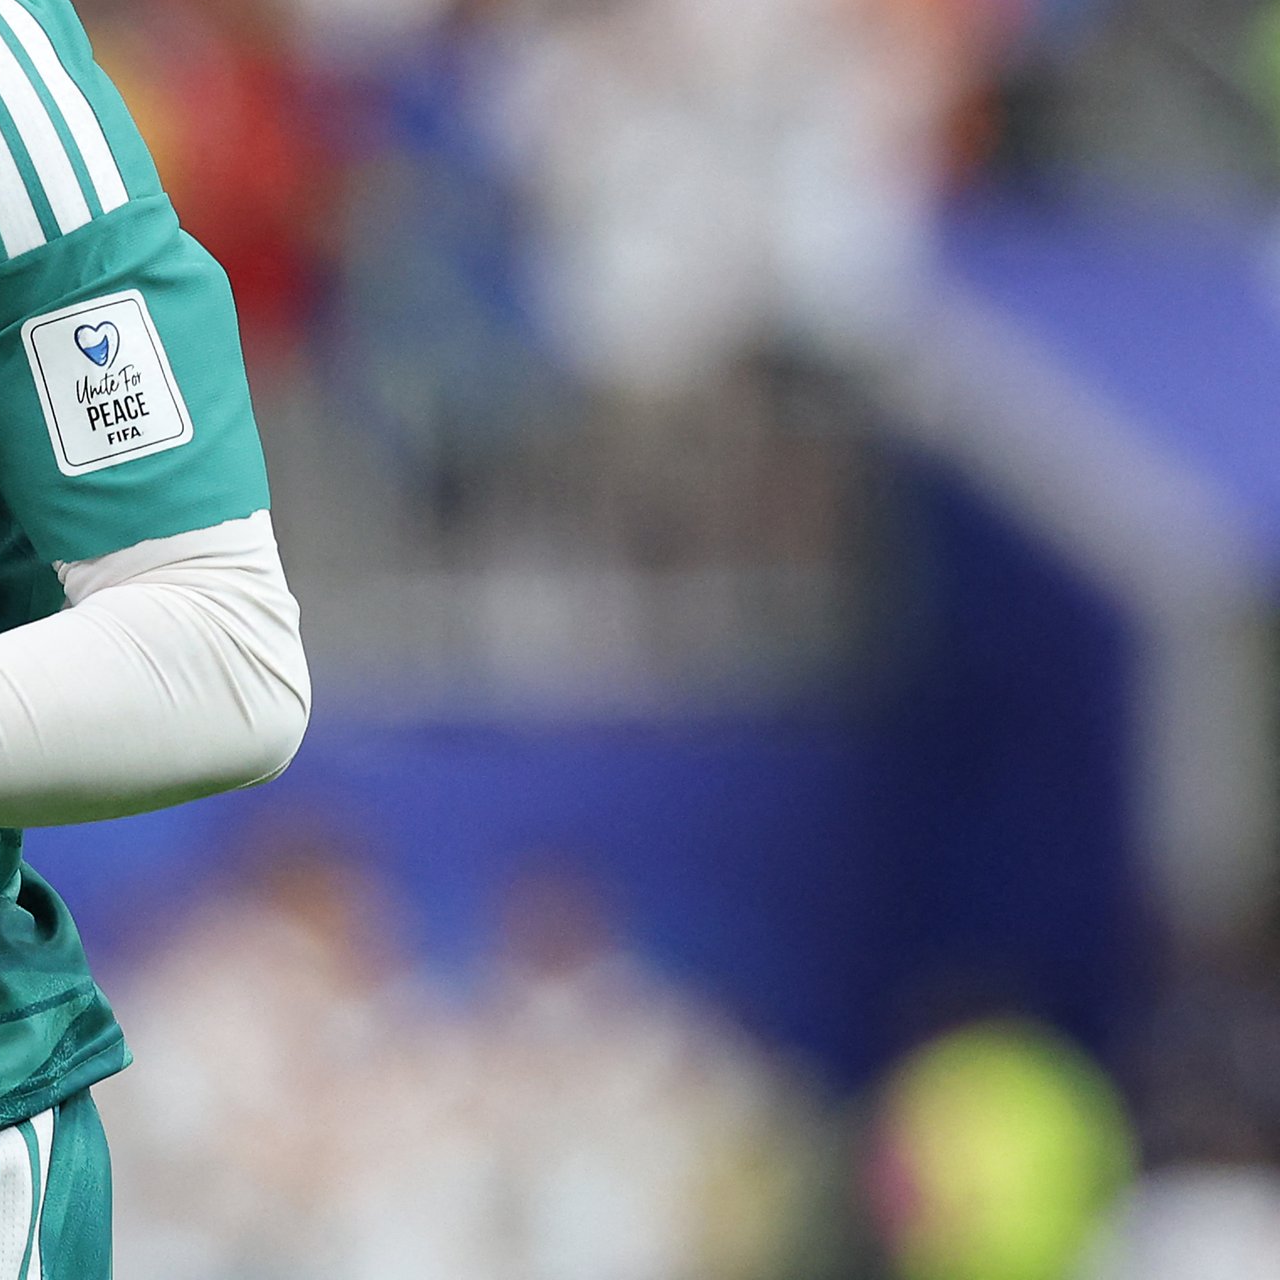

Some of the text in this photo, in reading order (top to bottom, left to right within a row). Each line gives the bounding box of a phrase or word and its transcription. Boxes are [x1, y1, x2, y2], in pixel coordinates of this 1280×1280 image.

[77, 364, 142, 405] Unite For
[86, 393, 149, 431] PEACE
[107, 426, 141, 445] FIFA
